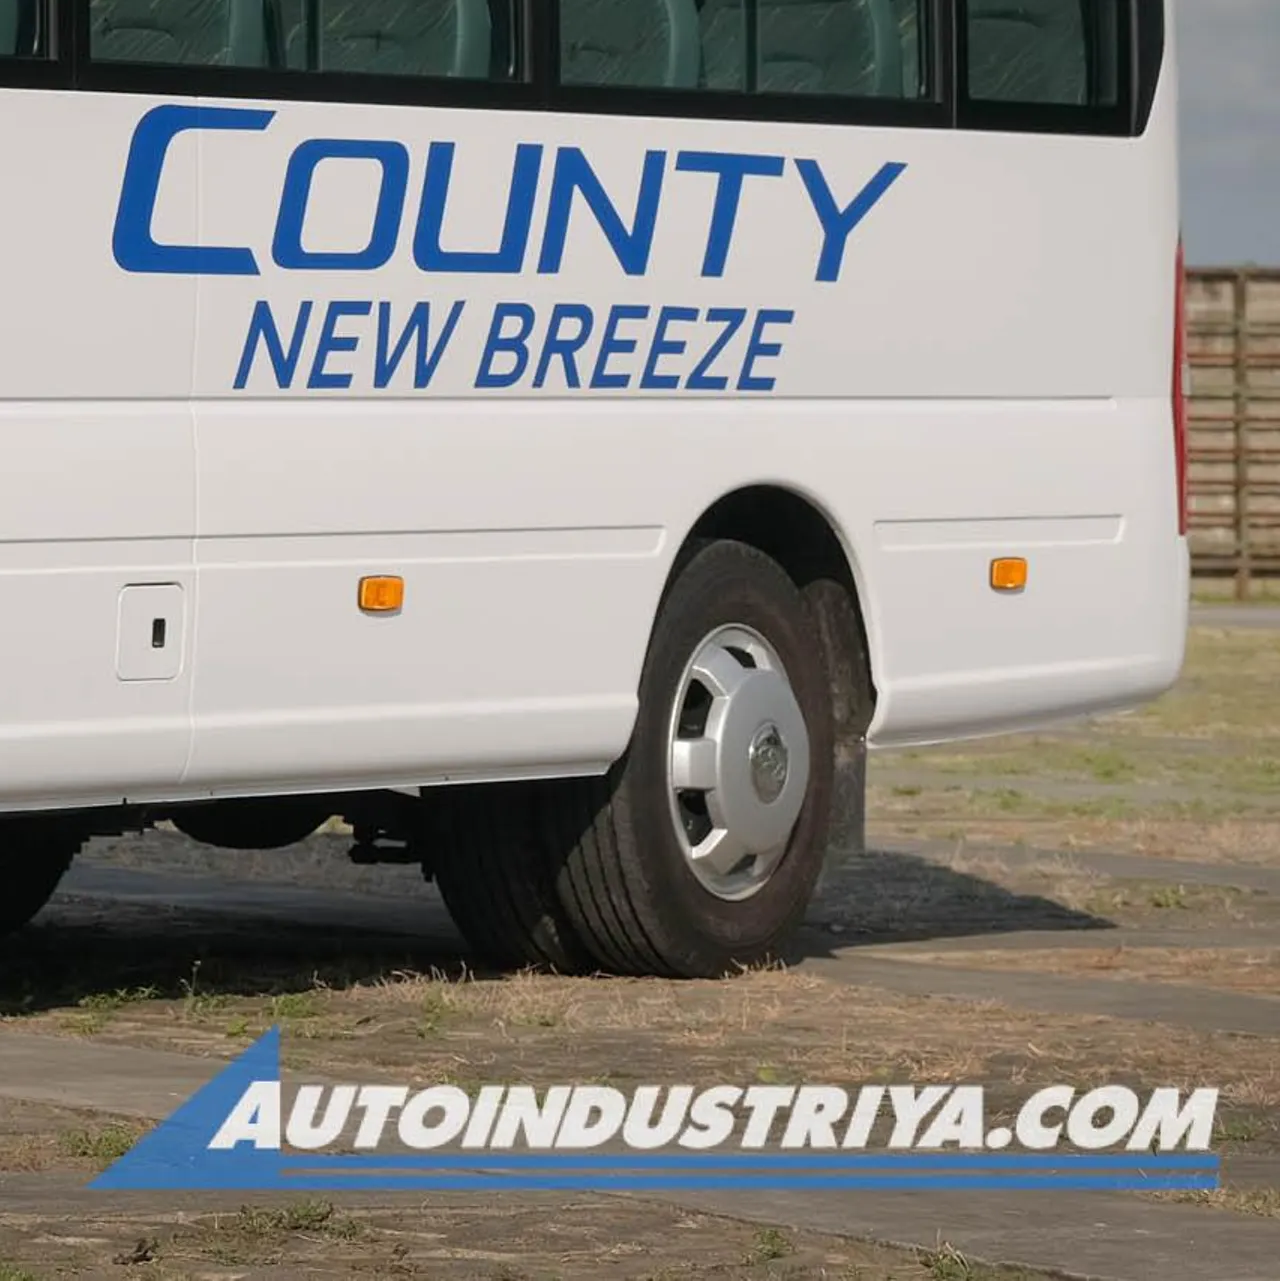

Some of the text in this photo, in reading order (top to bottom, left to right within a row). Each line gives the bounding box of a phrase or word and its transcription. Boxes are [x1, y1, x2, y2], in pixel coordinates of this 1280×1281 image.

[112, 104, 907, 282] COUNTY
[233, 301, 794, 391] NEW BREEZE
